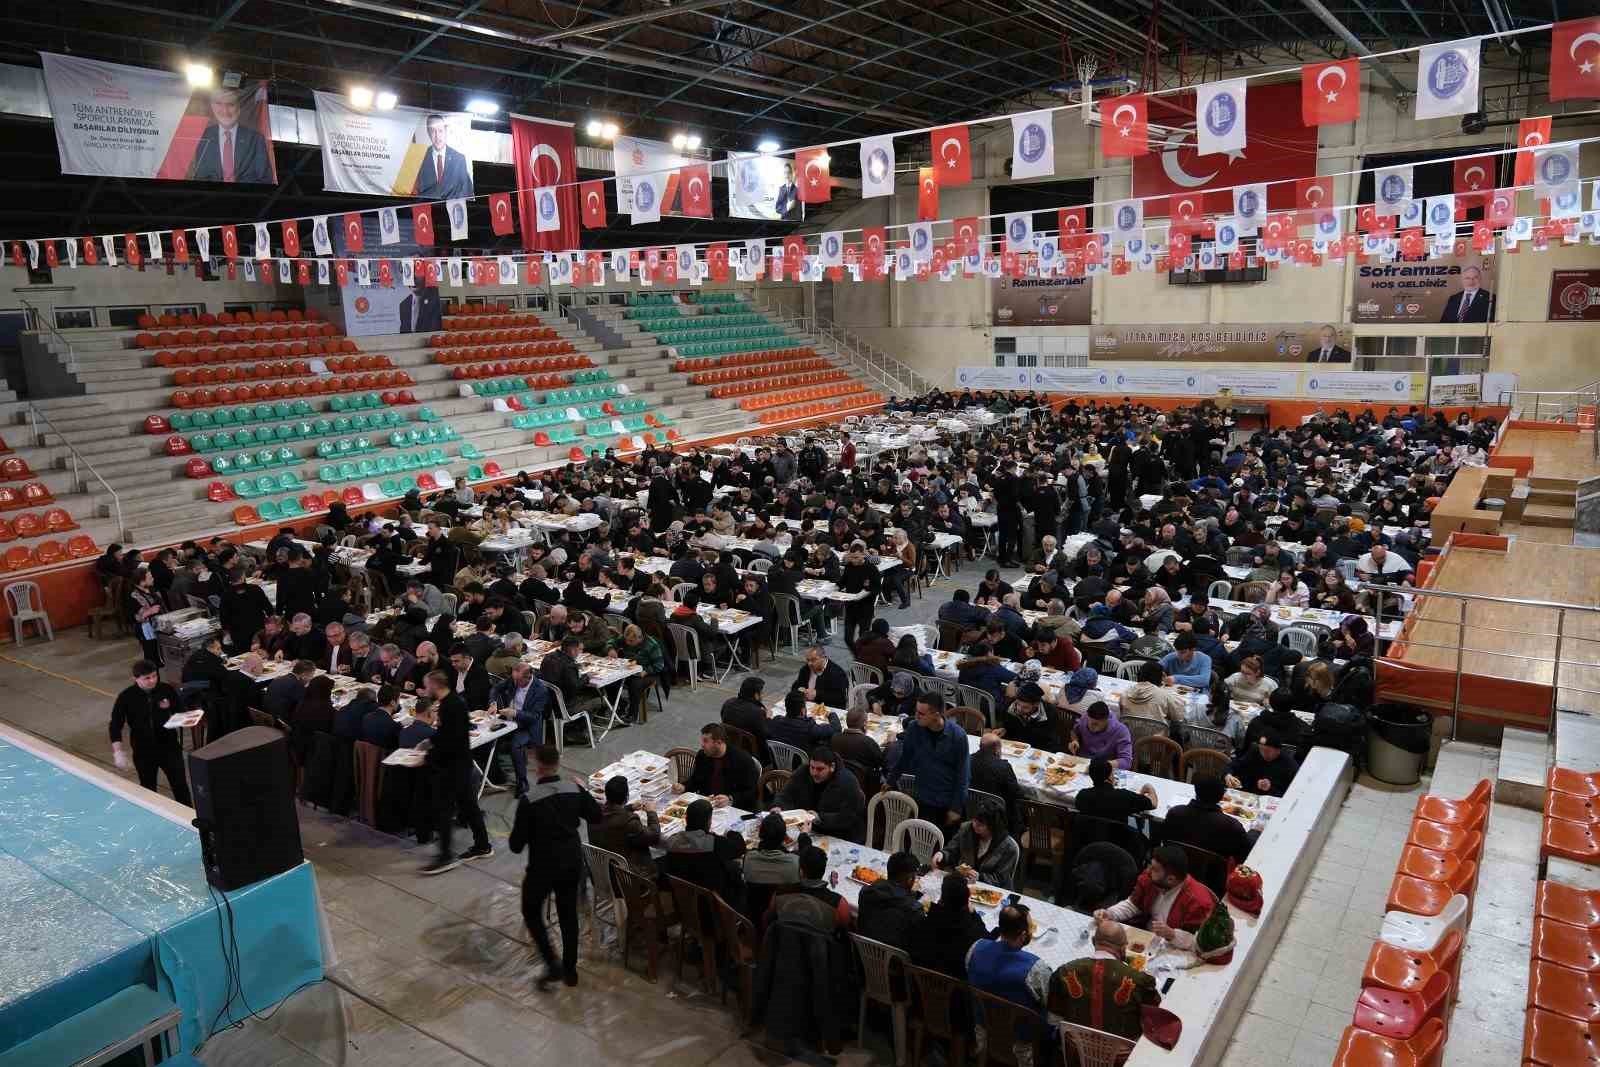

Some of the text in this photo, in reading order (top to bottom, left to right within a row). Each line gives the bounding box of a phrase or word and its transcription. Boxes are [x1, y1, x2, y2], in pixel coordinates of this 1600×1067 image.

[72, 103, 93, 113] TÜM
[95, 105, 143, 117] ANTRENÖR
[76, 112, 152, 127] SPORCULARIMIZA
[73, 122, 159, 136] BAŞARILAR DİLİYORUM
[1360, 264, 1462, 277] Soframıza
[1371, 279, 1448, 290] HOŞ GELDİNİZ
